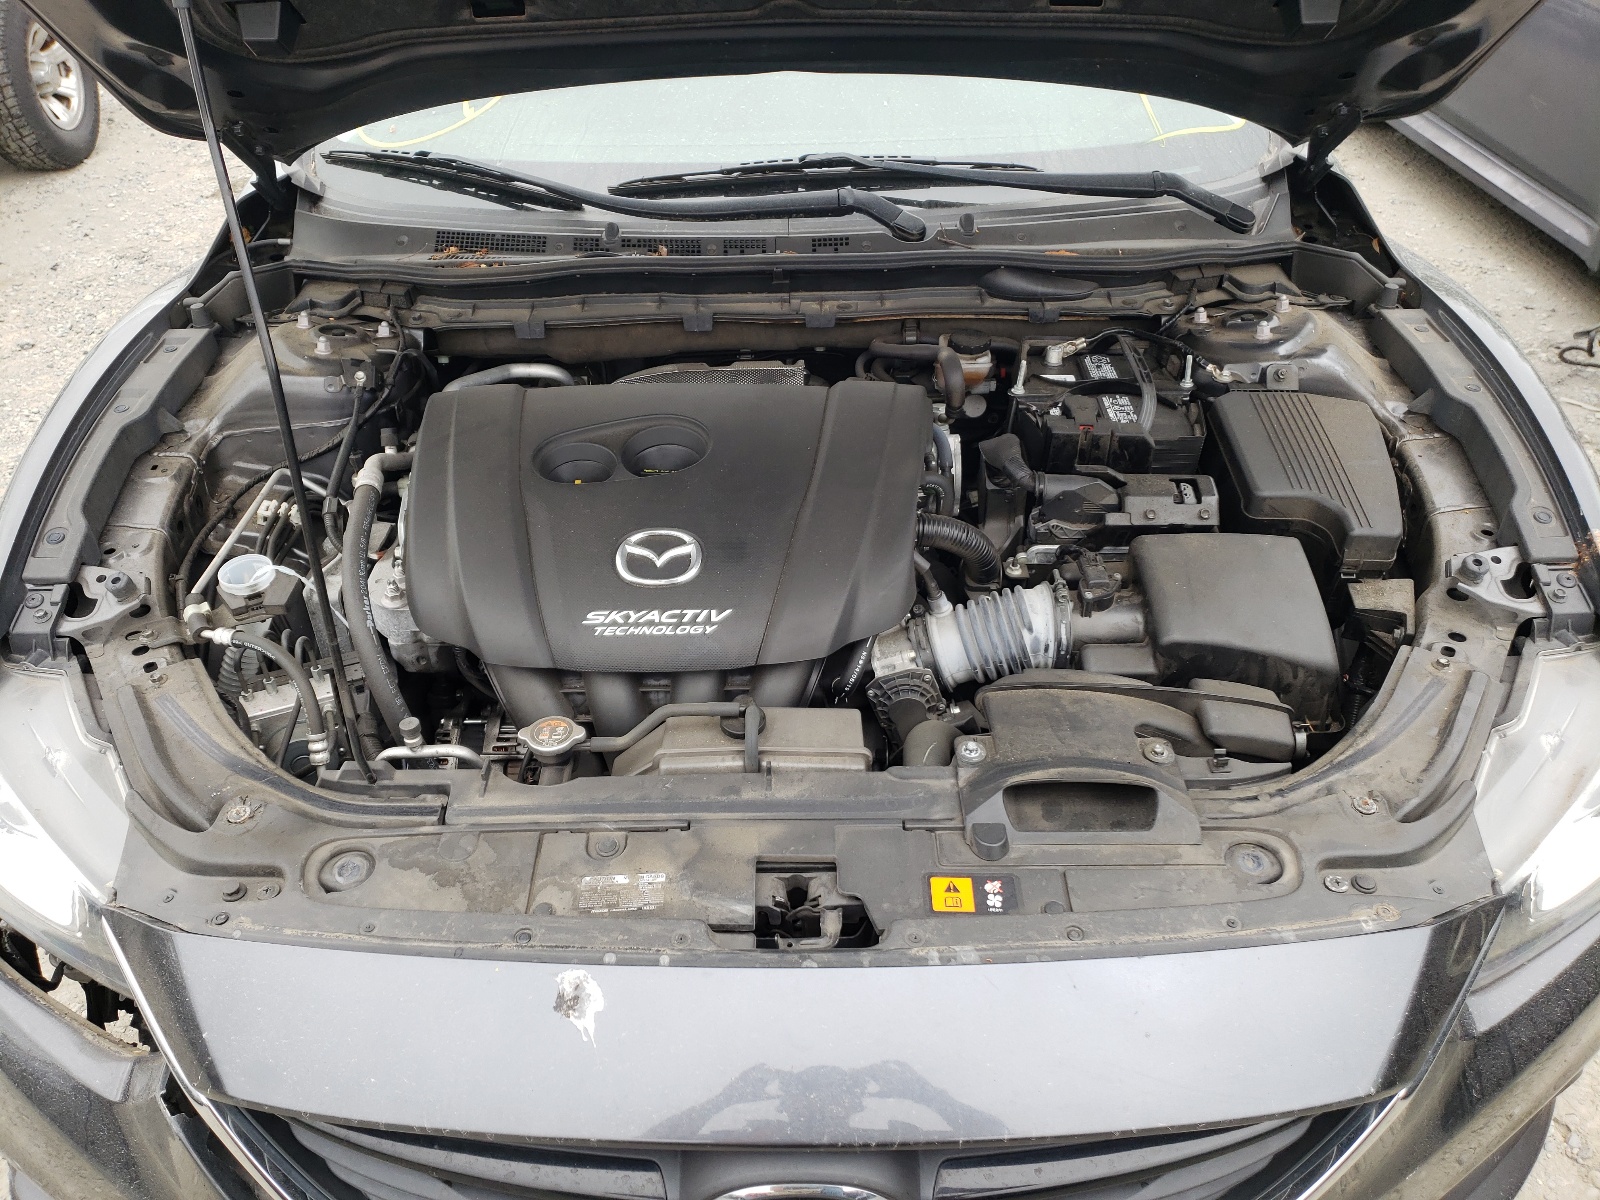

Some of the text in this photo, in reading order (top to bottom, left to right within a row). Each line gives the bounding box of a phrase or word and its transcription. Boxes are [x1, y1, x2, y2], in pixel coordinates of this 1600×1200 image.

[363, 595, 375, 628] Parker
[581, 609, 733, 624] SKYACTIV
[593, 625, 718, 636] TECHNOLOGY
